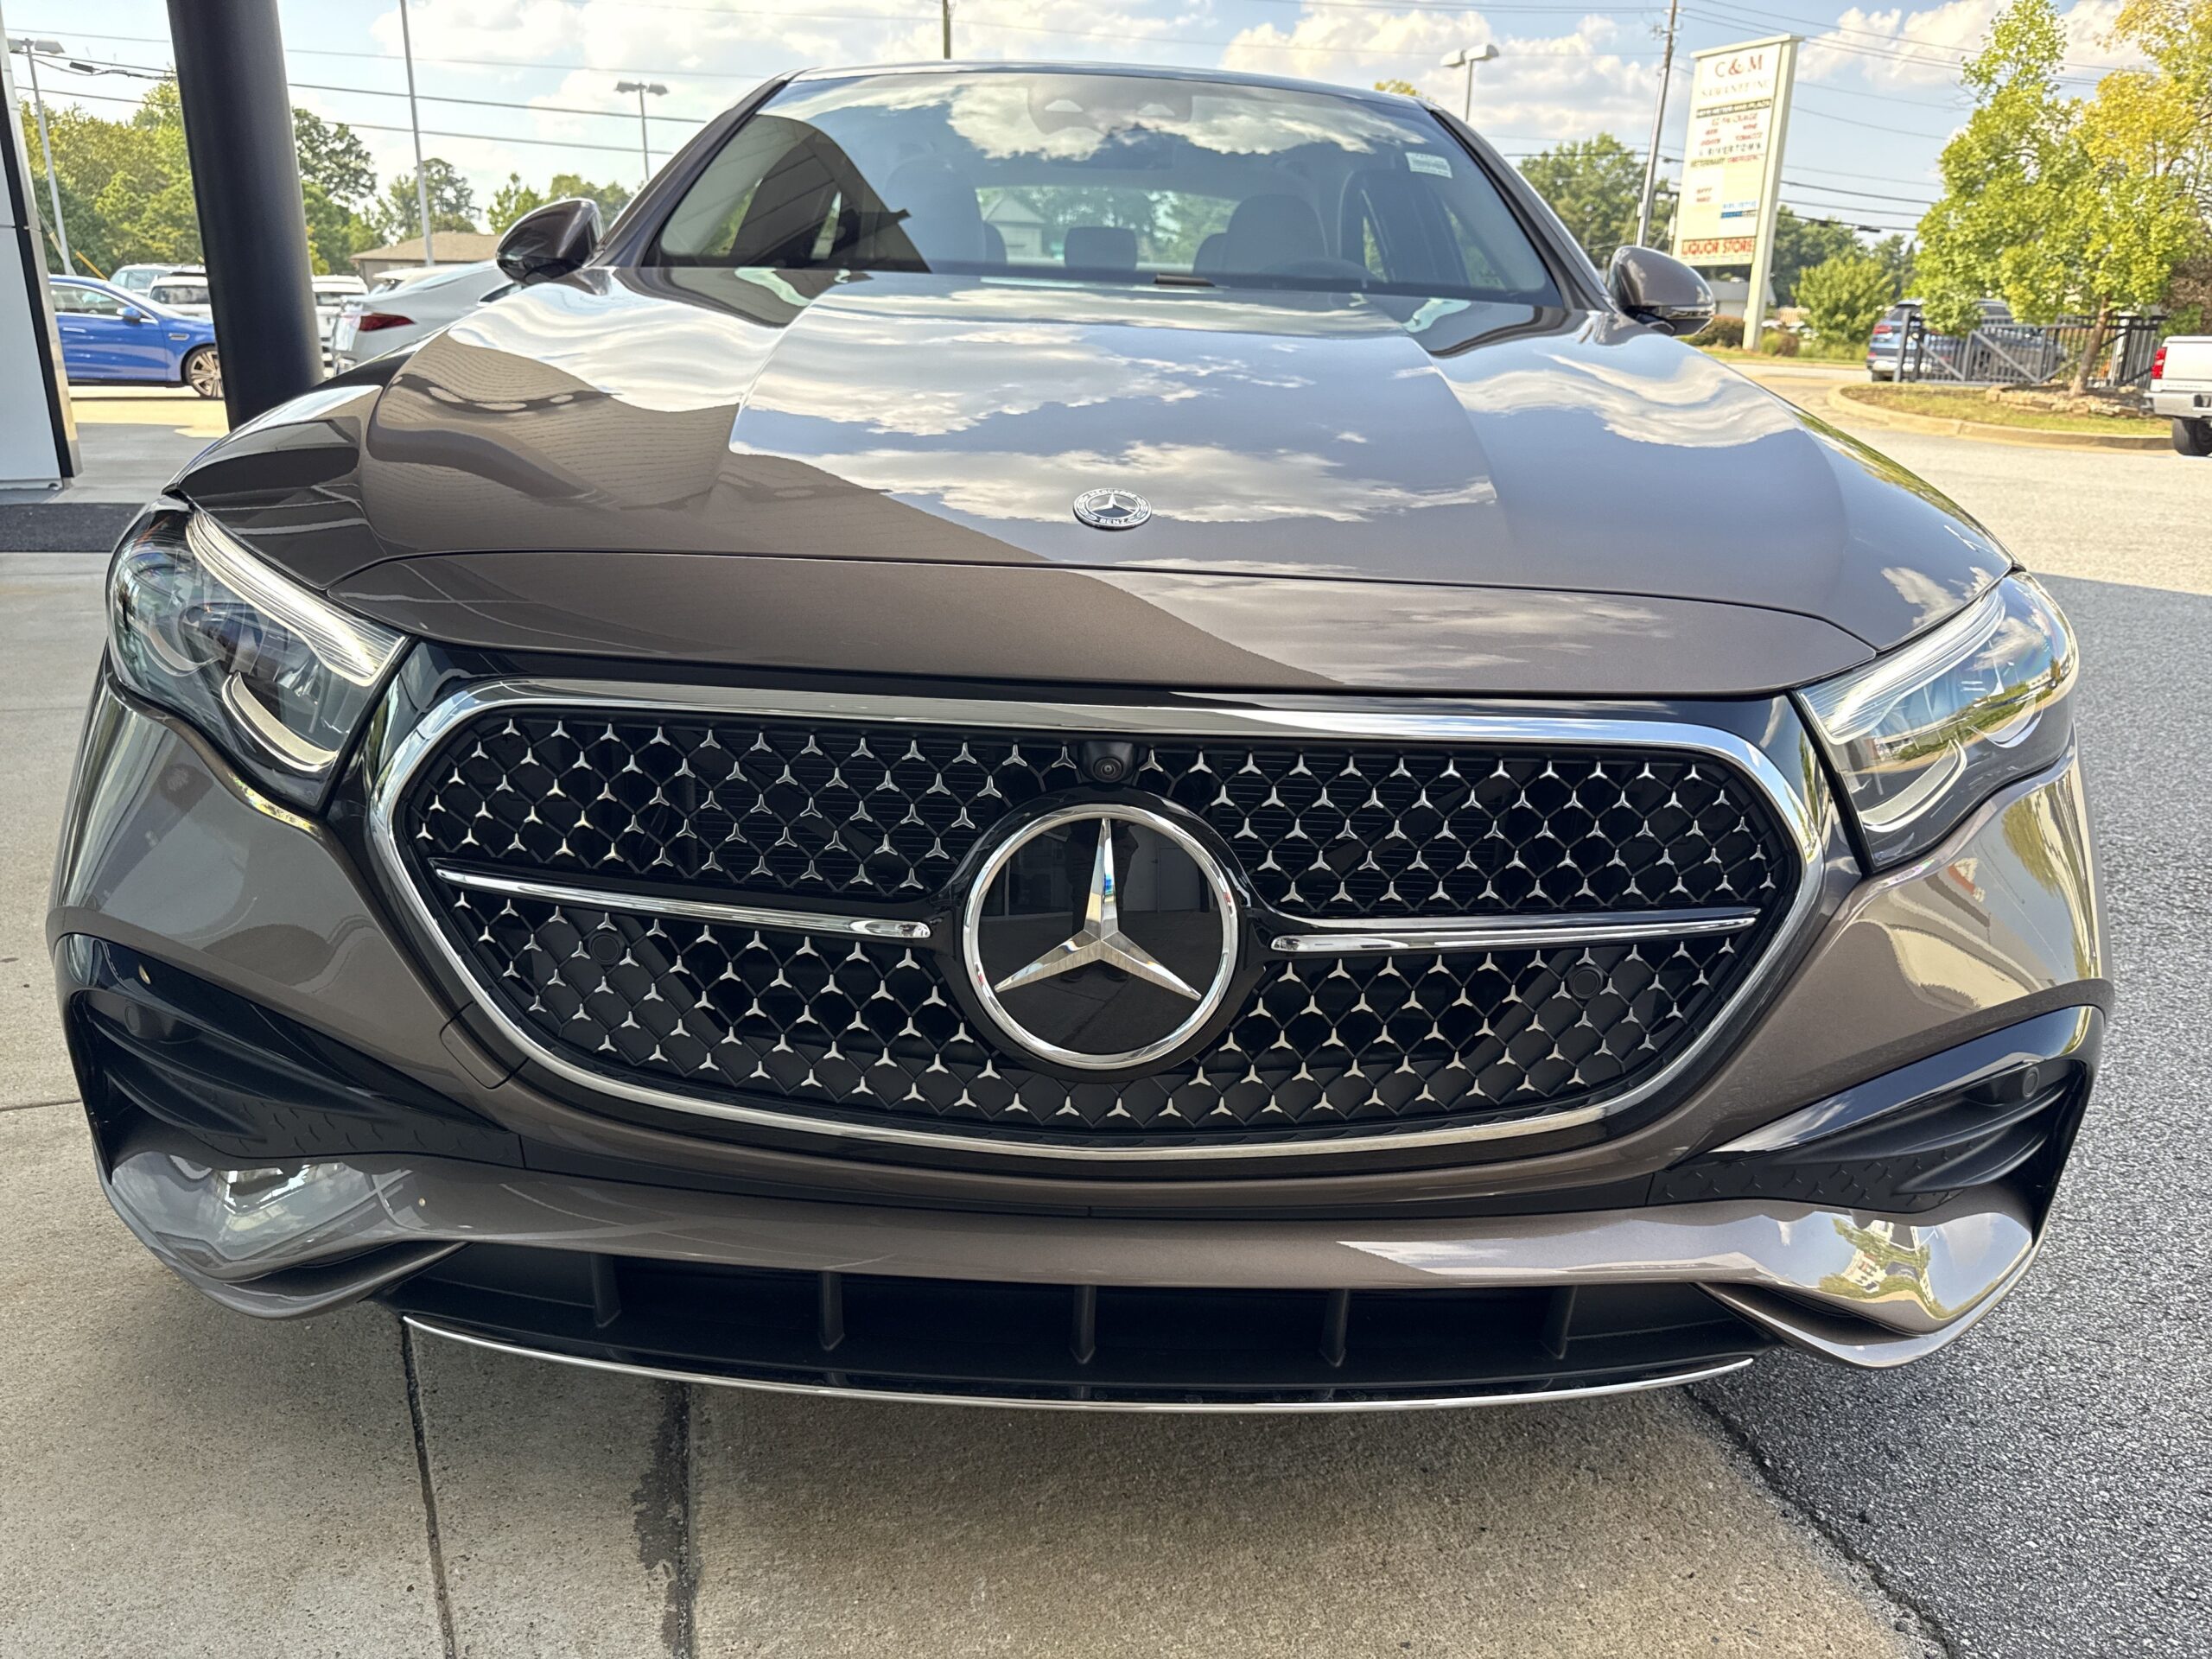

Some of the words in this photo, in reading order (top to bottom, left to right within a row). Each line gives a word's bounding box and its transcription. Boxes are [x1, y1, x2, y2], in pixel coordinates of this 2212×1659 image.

[1715, 61, 1726, 78] C
[1728, 58, 1743, 75] &
[1747, 54, 1763, 72] M
[1681, 240, 1719, 256] LIQUOR
